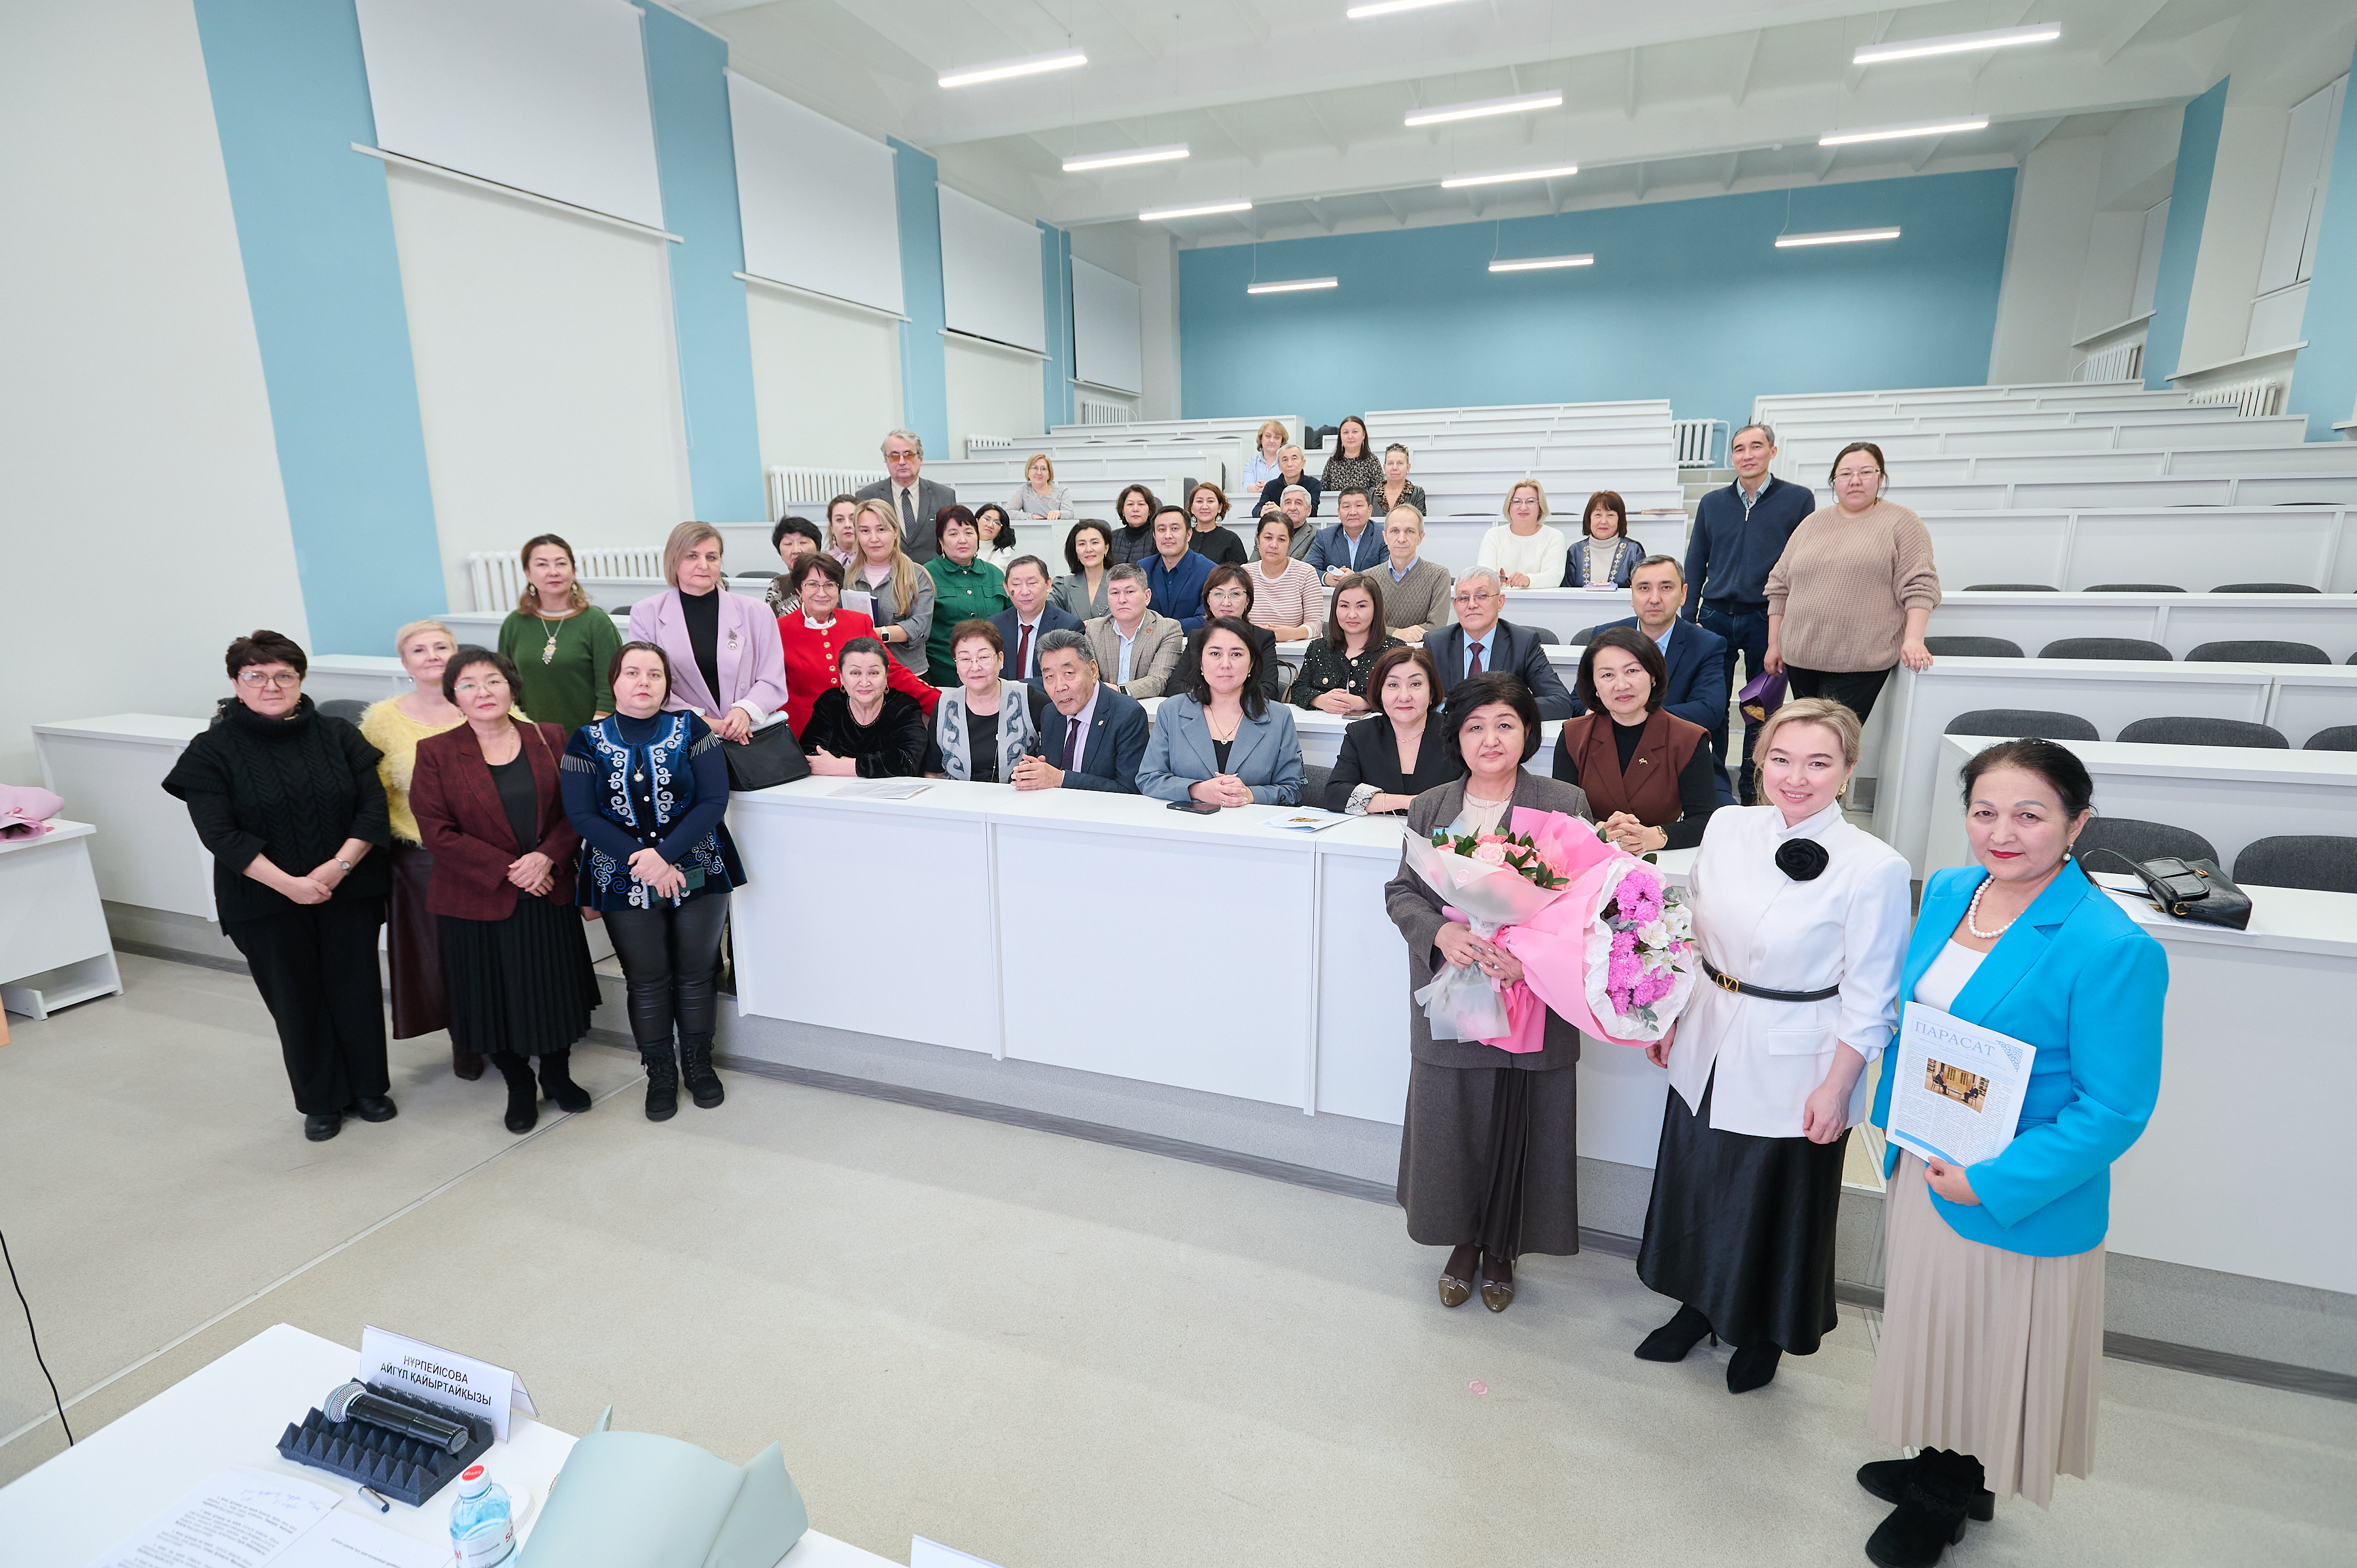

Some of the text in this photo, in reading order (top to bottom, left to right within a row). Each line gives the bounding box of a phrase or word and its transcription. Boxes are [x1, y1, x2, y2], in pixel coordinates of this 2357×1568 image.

[1915, 1021, 1995, 1056] ПАРАСАТ
[380, 1362, 491, 1406] АЙГҮЛ ҚАЙЫРТАЙҚЫЗЫ
[404, 1355, 468, 1384] НҰРПЕЙІСОВА
